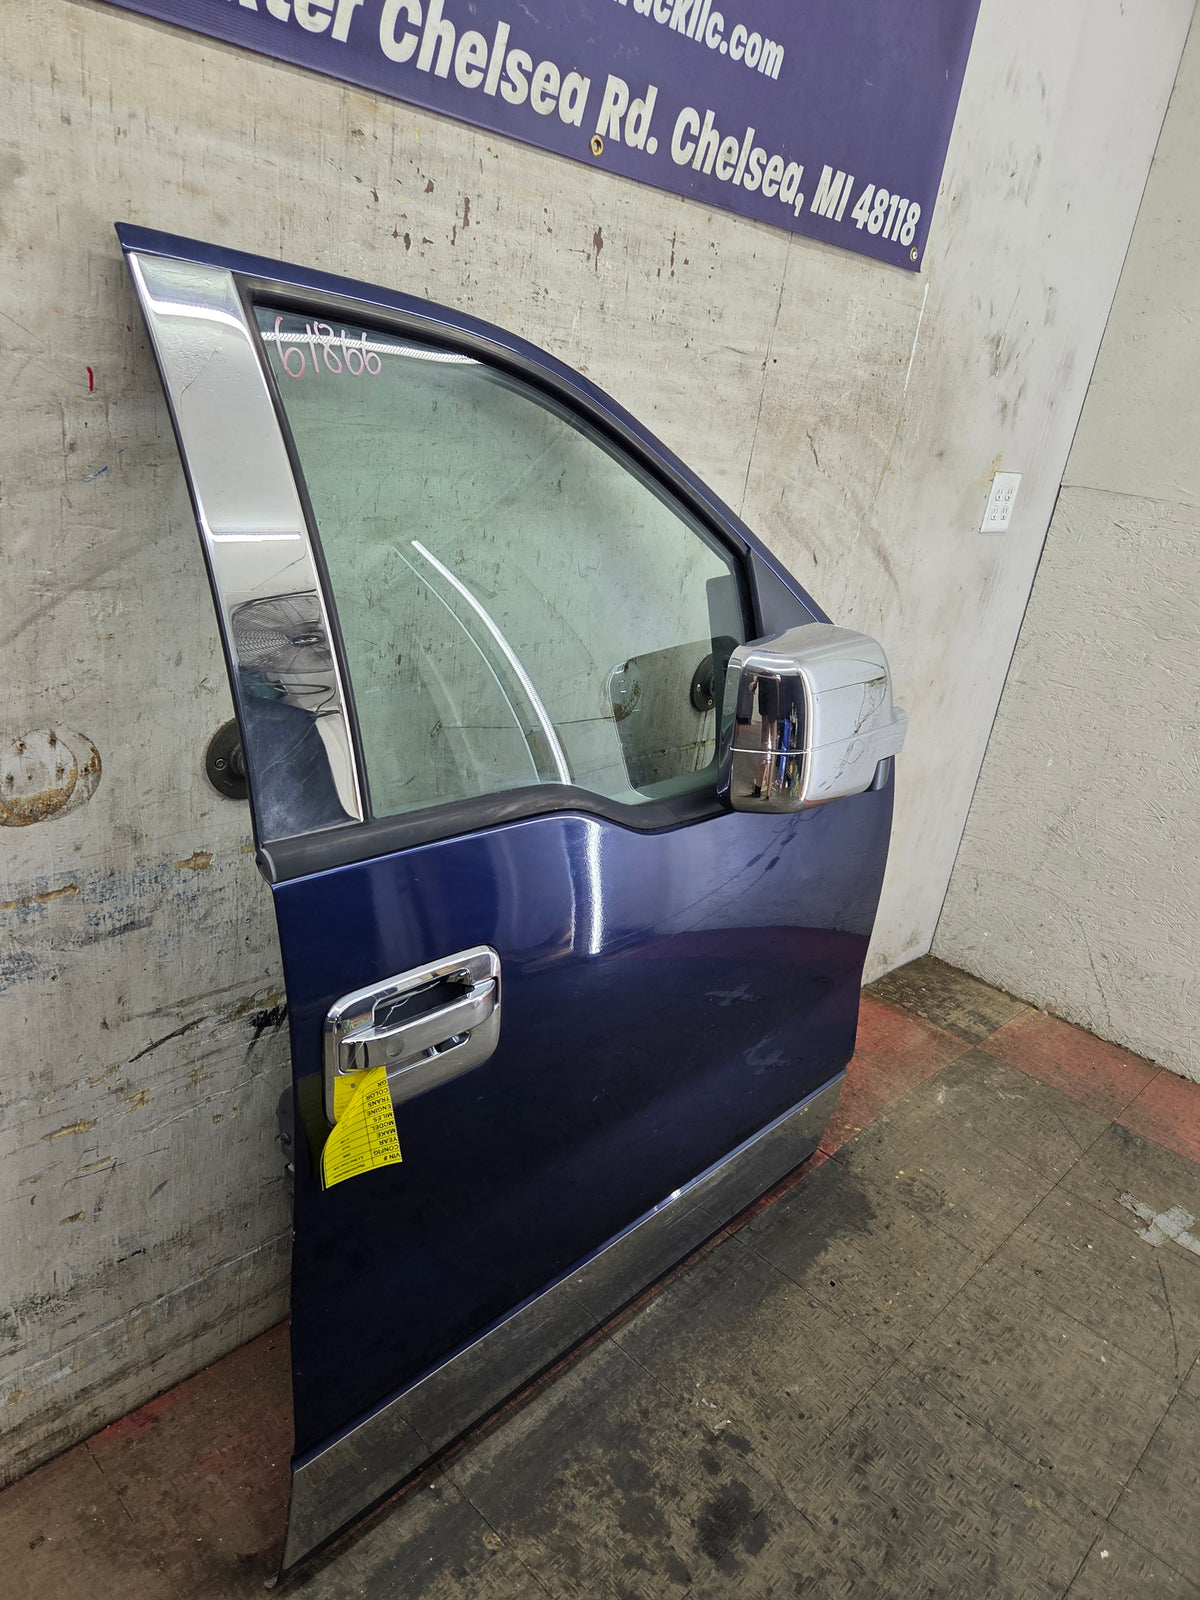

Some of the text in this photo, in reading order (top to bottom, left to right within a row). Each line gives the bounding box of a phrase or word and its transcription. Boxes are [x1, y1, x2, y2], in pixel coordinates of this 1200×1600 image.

[379, 0, 591, 128] Chelsea
[595, 74, 658, 155] Rd.
[671, 106, 804, 217] Chelsea,
[810, 164, 855, 222] MI
[851, 183, 921, 247] 48118
[366, 1088, 388, 1100] COLOR
[367, 1096, 390, 1107] TRANS
[367, 1104, 392, 1116] ENGINE
[372, 1112, 393, 1122] MILES
[371, 1120, 394, 1131] MODEL
[377, 1128, 396, 1138] MAKE
[378, 1137, 398, 1146] YEAR
[373, 1145, 399, 1156] CONFIG
